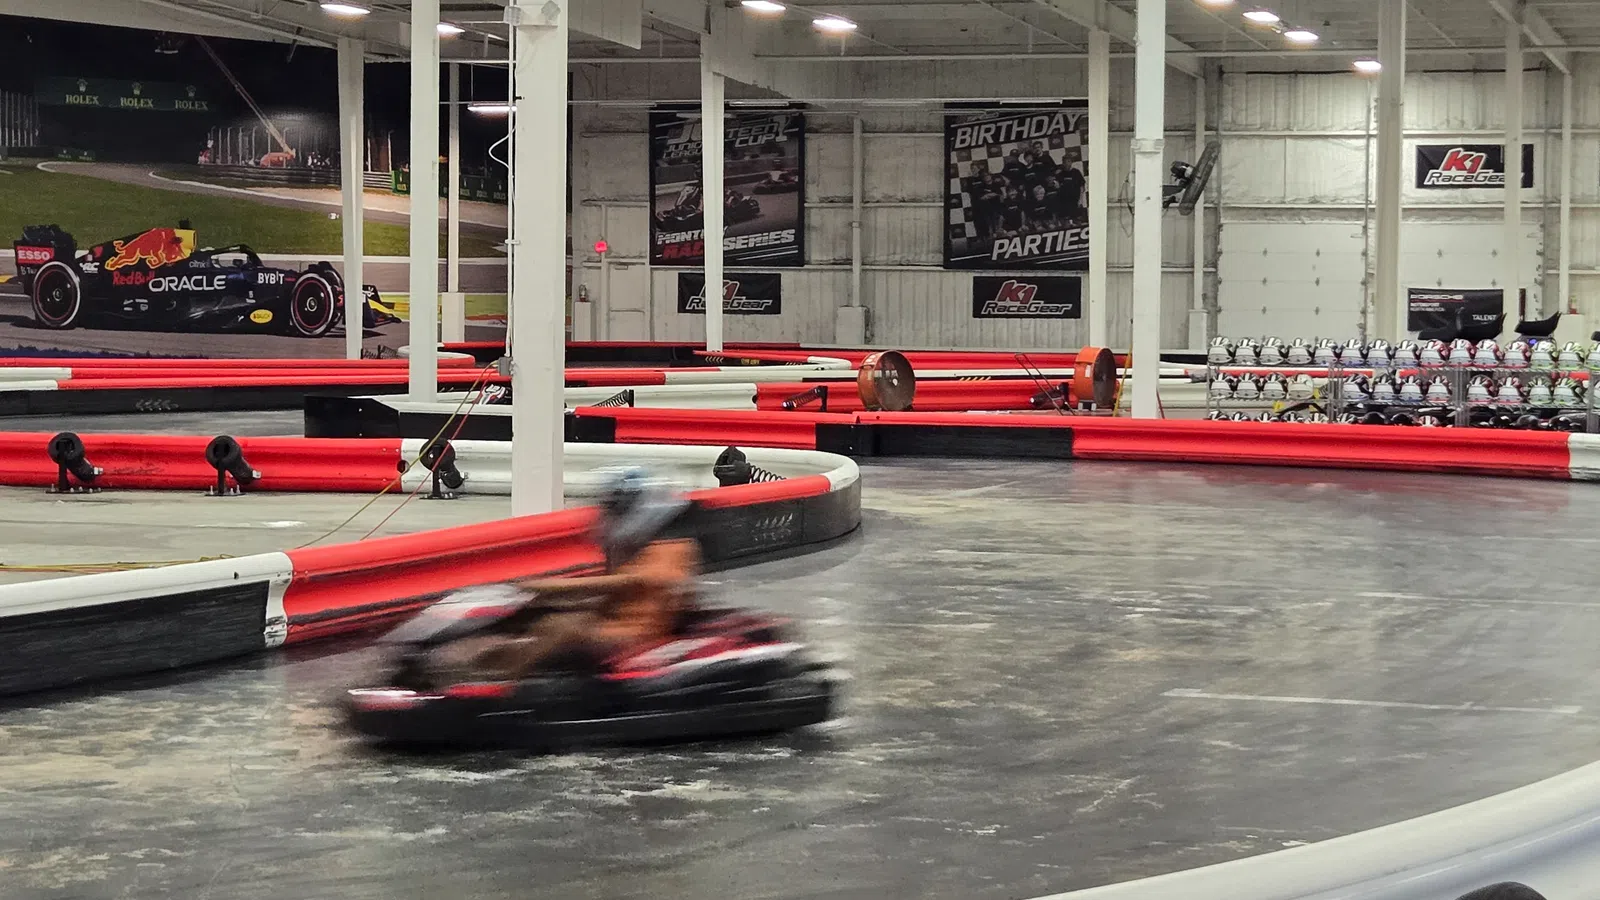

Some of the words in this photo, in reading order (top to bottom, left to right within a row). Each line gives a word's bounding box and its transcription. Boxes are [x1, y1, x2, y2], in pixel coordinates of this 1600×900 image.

[65, 94, 99, 105] ROLEX
[120, 97, 154, 108] ROLEX
[175, 99, 209, 111] ROLEX
[726, 123, 778, 138] TEEN
[954, 112, 1082, 149] BIRTHDAY
[666, 142, 703, 152] JUNIO
[735, 134, 775, 147] CUP
[662, 149, 703, 159] LEAGU
[1440, 148, 1487, 174] K1
[1424, 170, 1524, 185] RaceGea
[723, 229, 795, 251] SERIES
[18, 250, 50, 260] ESSO
[663, 241, 704, 258] RAC
[149, 275, 226, 292] ORACLE
[257, 271, 285, 284] BYBIT
[995, 280, 1037, 305] K1
[981, 301, 1072, 315] RaceGear
